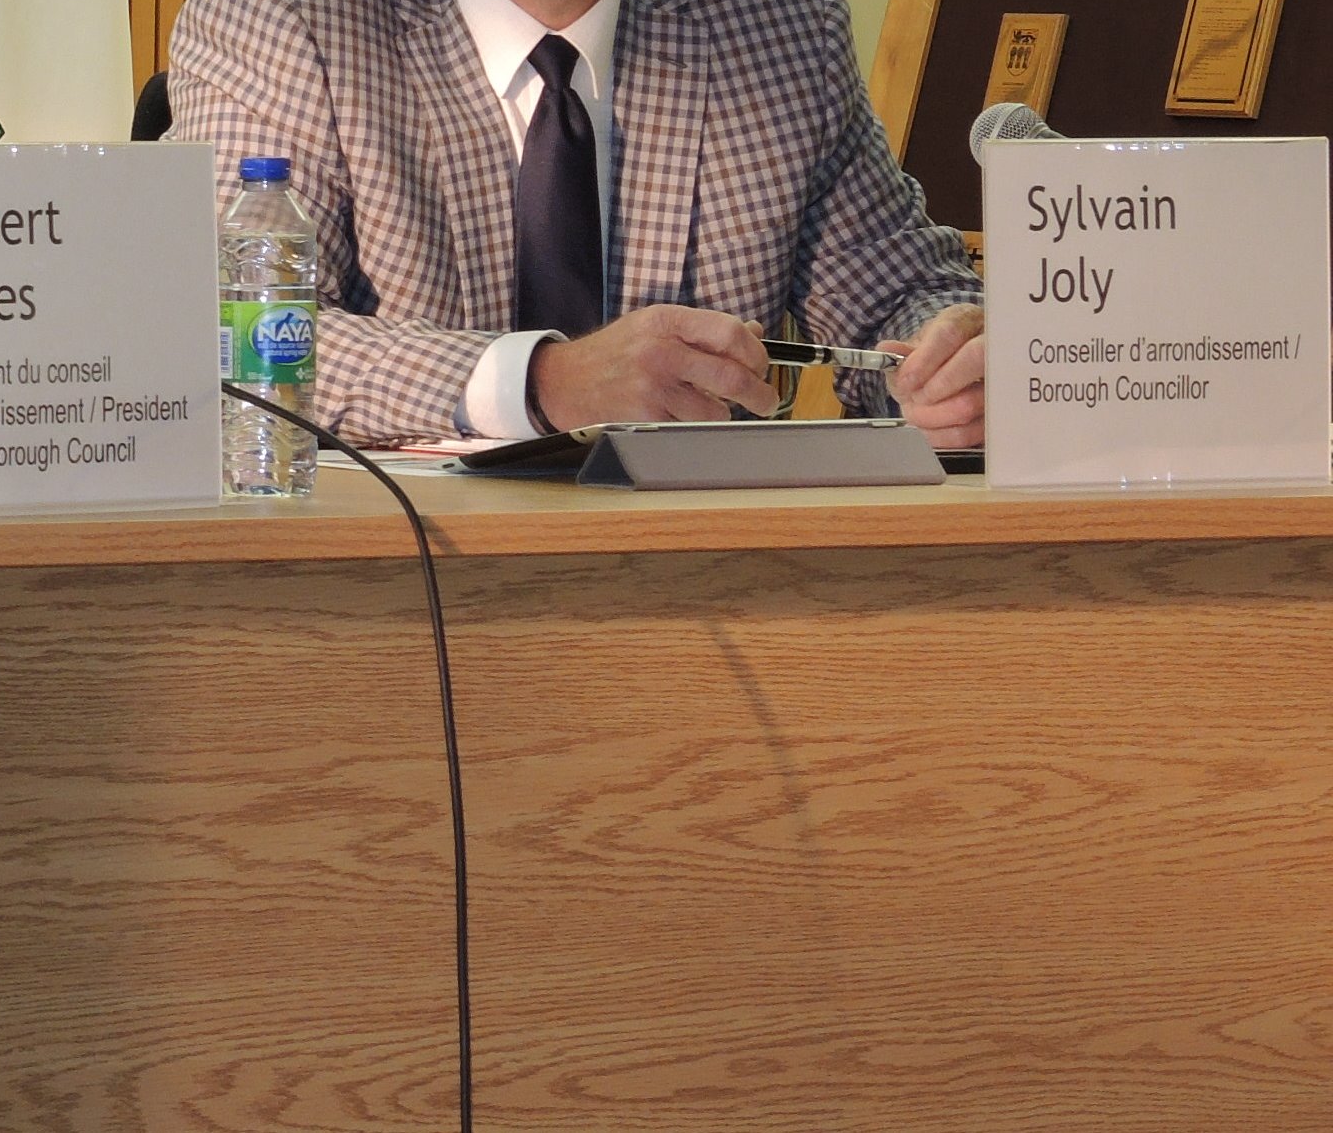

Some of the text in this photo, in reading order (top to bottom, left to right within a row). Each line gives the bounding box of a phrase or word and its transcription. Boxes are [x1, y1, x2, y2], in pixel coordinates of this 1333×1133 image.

[1027, 184, 1177, 244] Sylvain
[1028, 255, 1115, 314] Joly
[257, 322, 313, 342] NAYA
[1028, 333, 1303, 365] Conseiller d'arrondissement /
[17, 358, 42, 385] du
[47, 355, 112, 384] conseil
[1029, 373, 1211, 409] Borough Councillor
[89, 396, 97, 424] /
[102, 394, 190, 423] President
[67, 435, 137, 465] Council
